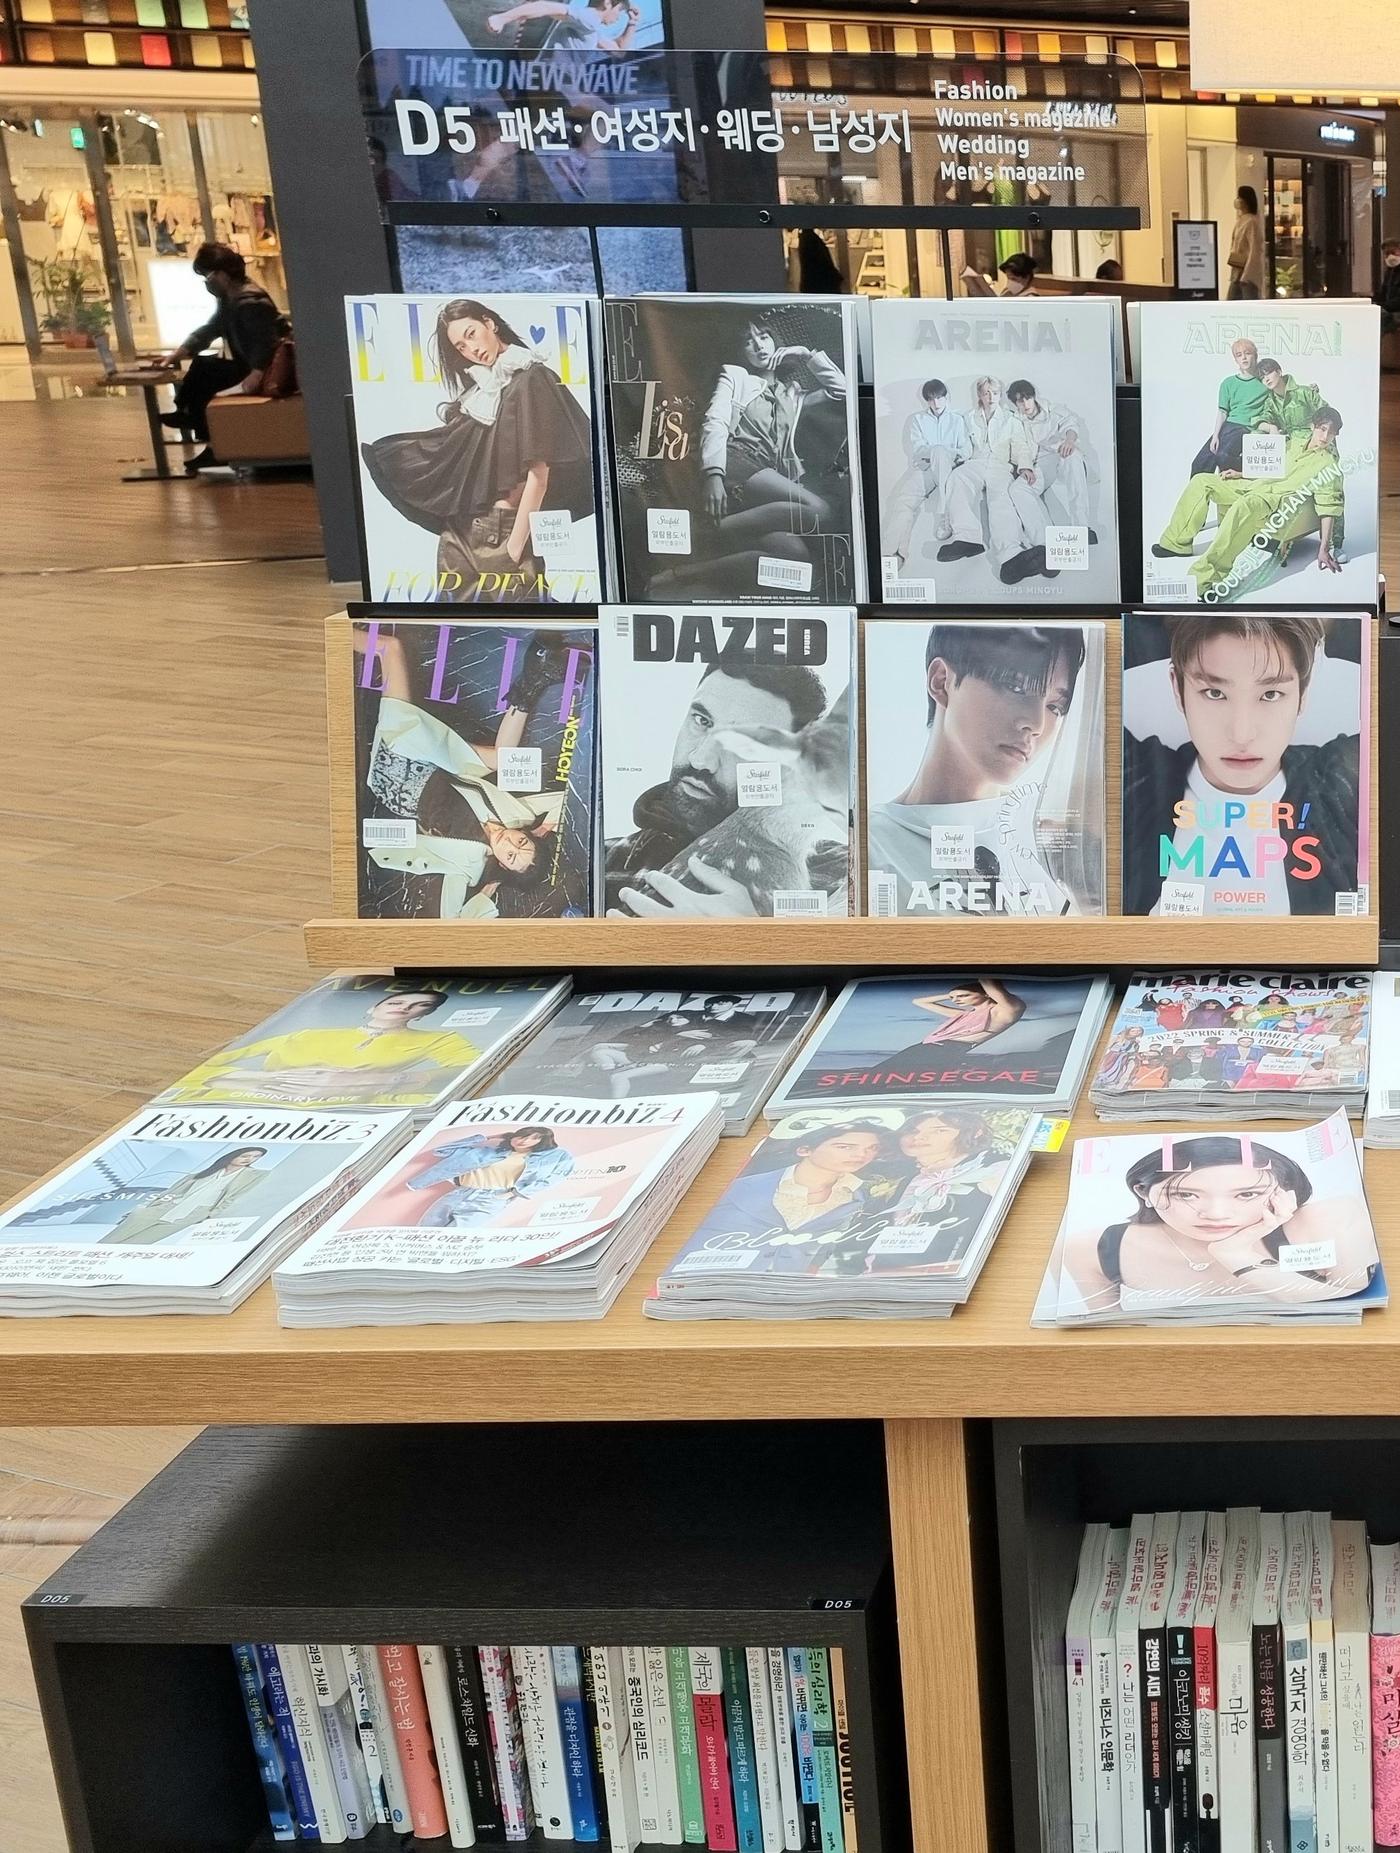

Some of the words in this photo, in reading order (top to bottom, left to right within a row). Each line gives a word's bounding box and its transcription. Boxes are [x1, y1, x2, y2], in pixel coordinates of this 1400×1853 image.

[406, 54, 468, 88] TIME
[472, 58, 503, 90] TO
[575, 61, 640, 95] WAVE
[933, 79, 1018, 100] Fashion
[395, 99, 477, 156] D5
[934, 107, 1019, 128] Women's
[1024, 111, 1114, 132] magazine
[937, 134, 1030, 159] Wedding
[940, 161, 994, 181] Men's
[1000, 164, 1086, 185] magazine
[352, 302, 589, 385] ELE
[914, 319, 1064, 353] ARENA
[1182, 320, 1335, 357] ARENA
[383, 571, 463, 603] FOR
[632, 613, 828, 667] DAZED
[554, 715, 582, 783] HOYEON
[1172, 799, 1312, 830] SUPER!
[1159, 834, 1322, 880] MAPS
[906, 881, 1055, 912] ARENA
[1213, 891, 1266, 904] POWER
[1131, 968, 1257, 988] marie
[1259, 972, 1371, 991] claire
[1150, 1031, 1180, 1043] 2022
[1183, 1029, 1225, 1038] SPRING
[1230, 1029, 1238, 1037] &
[1243, 1030, 1292, 1040] SUMMER
[1257, 1038, 1326, 1051] COLLECTION
[817, 1069, 1040, 1087] SHINSEGAE
[130, 1112, 355, 1141] Fashionbiz
[354, 1123, 379, 1139] 3
[447, 1100, 660, 1127] Fashionbiz
[660, 1106, 686, 1123] 4
[693, 1651, 713, 1691] 제국의
[1146, 1639, 1159, 1672] 강연의
[268, 1667, 284, 1704] 에고라는
[772, 1660, 784, 1692] 경영하라
[795, 1674, 805, 1687] 1%
[1147, 1676, 1161, 1697] 시대
[1289, 1666, 1308, 1713] 삼국지
[390, 1676, 409, 1715] 잘사는
[456, 1677, 475, 1726] 로스차일드
[628, 1677, 643, 1718] 중국인의
[796, 1688, 808, 1713] 바뀌면
[1174, 1670, 1191, 1716] 이코노믹
[1260, 1684, 1275, 1730] 성공한다
[397, 1718, 414, 1730] 법
[563, 1707, 577, 1733] 관점을
[1100, 1698, 1112, 1739] 비즈니스
[1175, 1717, 1192, 1739] 씽킹
[1199, 1710, 1213, 1758] 소셜마케팅
[465, 1728, 478, 1747] 신화
[632, 1721, 648, 1761] 심리코드
[801, 1733, 811, 1755] 100%
[1291, 1718, 1309, 1765] 경영학
[802, 1757, 814, 1781] 바뀐다
[1101, 1741, 1114, 1772] 인문학
